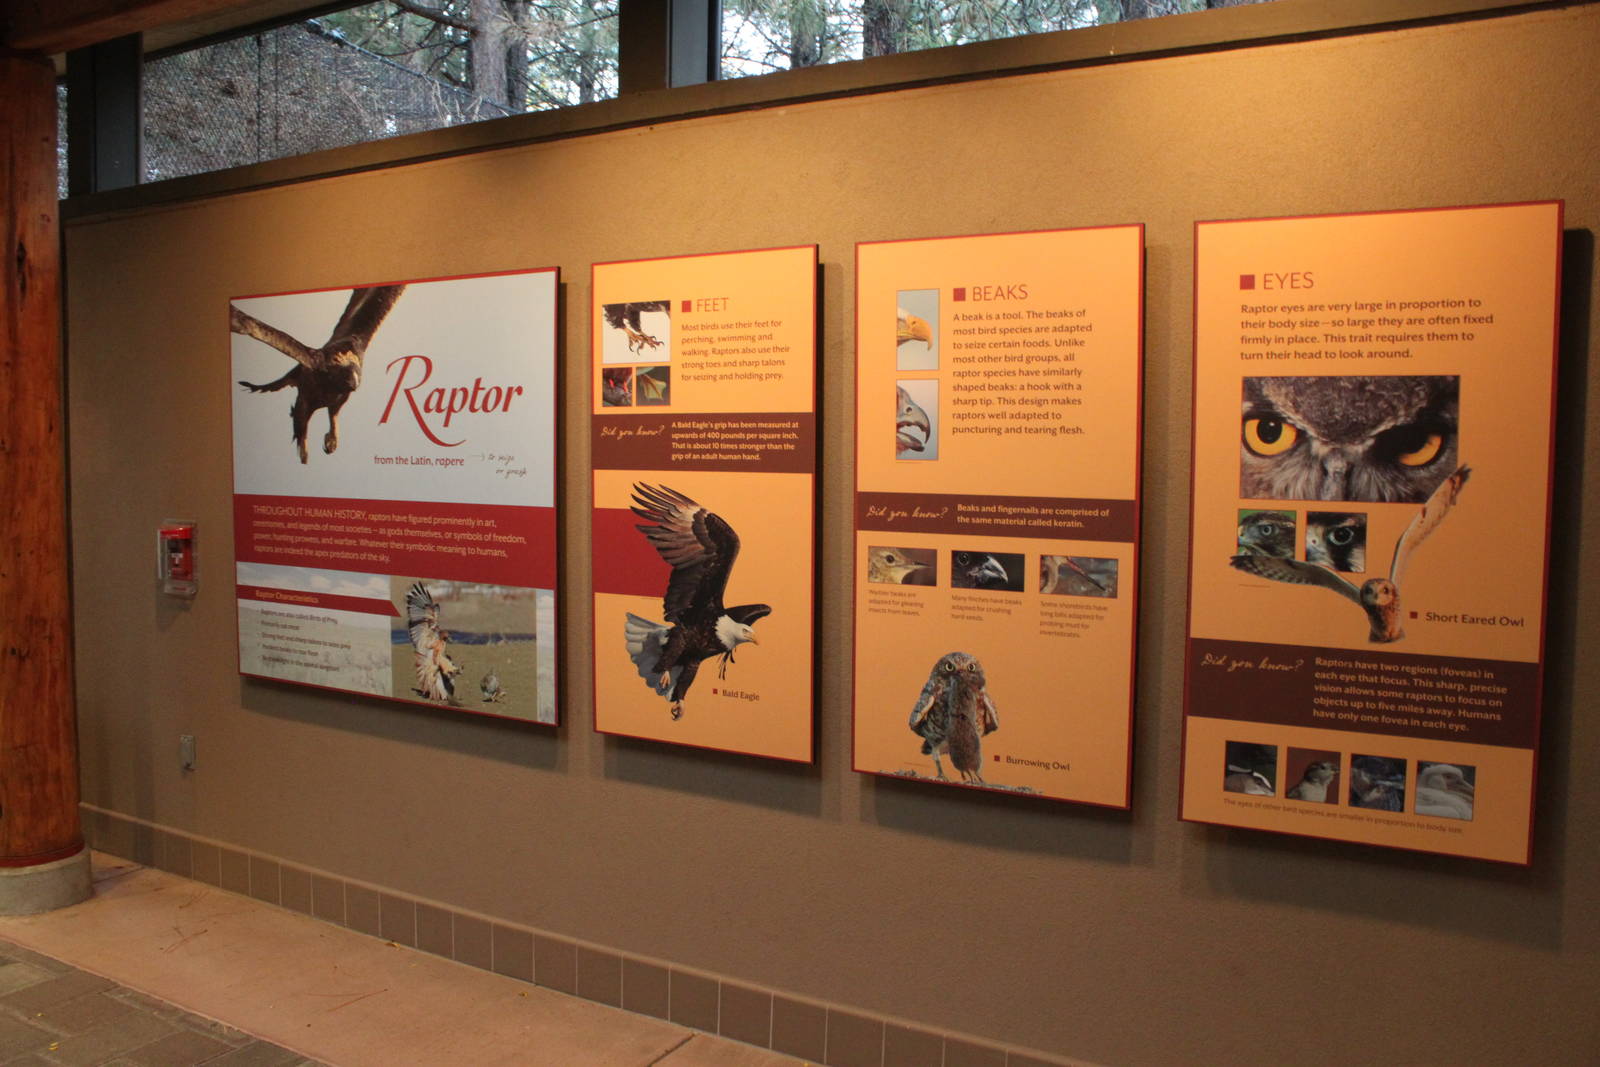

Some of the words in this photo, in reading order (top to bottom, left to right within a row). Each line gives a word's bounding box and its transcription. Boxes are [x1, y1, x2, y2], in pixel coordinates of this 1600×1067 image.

[1263, 272, 1314, 290] EYES
[972, 284, 1028, 302] BEAKS
[697, 297, 729, 312] FEET
[1240, 304, 1277, 315] Raptor
[1280, 305, 1304, 314] eyes
[1328, 304, 1351, 313] very
[1354, 301, 1382, 312] large
[1385, 300, 1396, 309] in
[1398, 299, 1465, 311] proportion
[1468, 298, 1481, 307] to
[961, 312, 983, 321] beak
[1026, 310, 1043, 318] The
[1045, 309, 1073, 318] beaks
[1076, 309, 1086, 317] of
[998, 327, 1032, 335] species
[1051, 323, 1092, 334] adapted
[964, 341, 986, 349] seize
[1022, 339, 1052, 348] foods.
[1054, 338, 1085, 346] Unlike
[1240, 335, 1271, 346] firmly
[1286, 334, 1319, 345] place.
[1324, 333, 1346, 343] This
[1349, 333, 1372, 342] trait
[1375, 332, 1423, 344] requires
[1426, 332, 1458, 341] them
[1461, 332, 1474, 340] to
[682, 348, 710, 357] walking.
[711, 347, 739, 355] Raptors
[977, 354, 1002, 362] other
[1025, 355, 1061, 364] groups,
[1063, 352, 1074, 361] all
[1266, 350, 1290, 359] their
[1293, 350, 1322, 359] head
[1338, 349, 1363, 358] look
[1366, 348, 1413, 358] around.
[682, 361, 704, 370] strong
[953, 370, 980, 379] raptor
[983, 370, 1016, 378] species
[1018, 368, 1040, 376] have
[1042, 367, 1082, 378] similarly
[378, 355, 523, 447] Raptor
[953, 397, 977, 406] sharp
[979, 397, 994, 406] tip.
[997, 396, 1016, 405] This
[1018, 397, 1048, 407] design
[1050, 396, 1081, 405] makes
[953, 412, 985, 420] raptors
[1008, 411, 1049, 421] adapted
[691, 421, 713, 429] Eagle's
[953, 426, 1002, 435] puncturing
[1024, 426, 1057, 436] tearing
[1059, 425, 1085, 434] flesh.
[600, 427, 616, 437] Did
[618, 429, 632, 440] you
[636, 425, 665, 436] know?
[374, 456, 394, 465] from
[396, 456, 409, 465] the
[410, 456, 434, 466] Latin,
[253, 504, 302, 516] THROUGHOUT
[304, 508, 332, 518] HUMAN
[334, 508, 367, 520] HISTORY,
[368, 513, 391, 522] raptors
[391, 513, 407, 522] have
[408, 514, 432, 525] figured
[432, 515, 475, 528] prominently
[484, 519, 497, 527] art,
[866, 506, 884, 517] Did
[888, 509, 908, 521] you
[912, 507, 948, 519] know?
[997, 505, 1038, 515] fingernails
[1054, 508, 1098, 517] comprised
[453, 530, 483, 542] symbols
[492, 533, 527, 544] freedom,
[1425, 612, 1458, 623] Short
[1461, 614, 1496, 625] Eared
[1499, 616, 1524, 626] Owl
[1201, 653, 1226, 668] Did
[1230, 659, 1253, 672] you
[1258, 656, 1304, 672] know?
[1314, 657, 1352, 668] Raptors
[1354, 661, 1378, 670] have
[1400, 664, 1437, 676] regions
[1440, 667, 1481, 678] (foveas)
[1314, 670, 1337, 679] each
[1339, 674, 1356, 682] eye
[1358, 673, 1378, 683] that
[1380, 675, 1410, 685] focus.
[1413, 678, 1433, 687] This
[1436, 680, 1467, 692] sharp,
[1469, 684, 1507, 695] precise
[722, 689, 738, 698] Bald
[740, 691, 760, 702] Eagle
[1006, 756, 1050, 770] Burrowing
[1052, 762, 1070, 771] Owl
